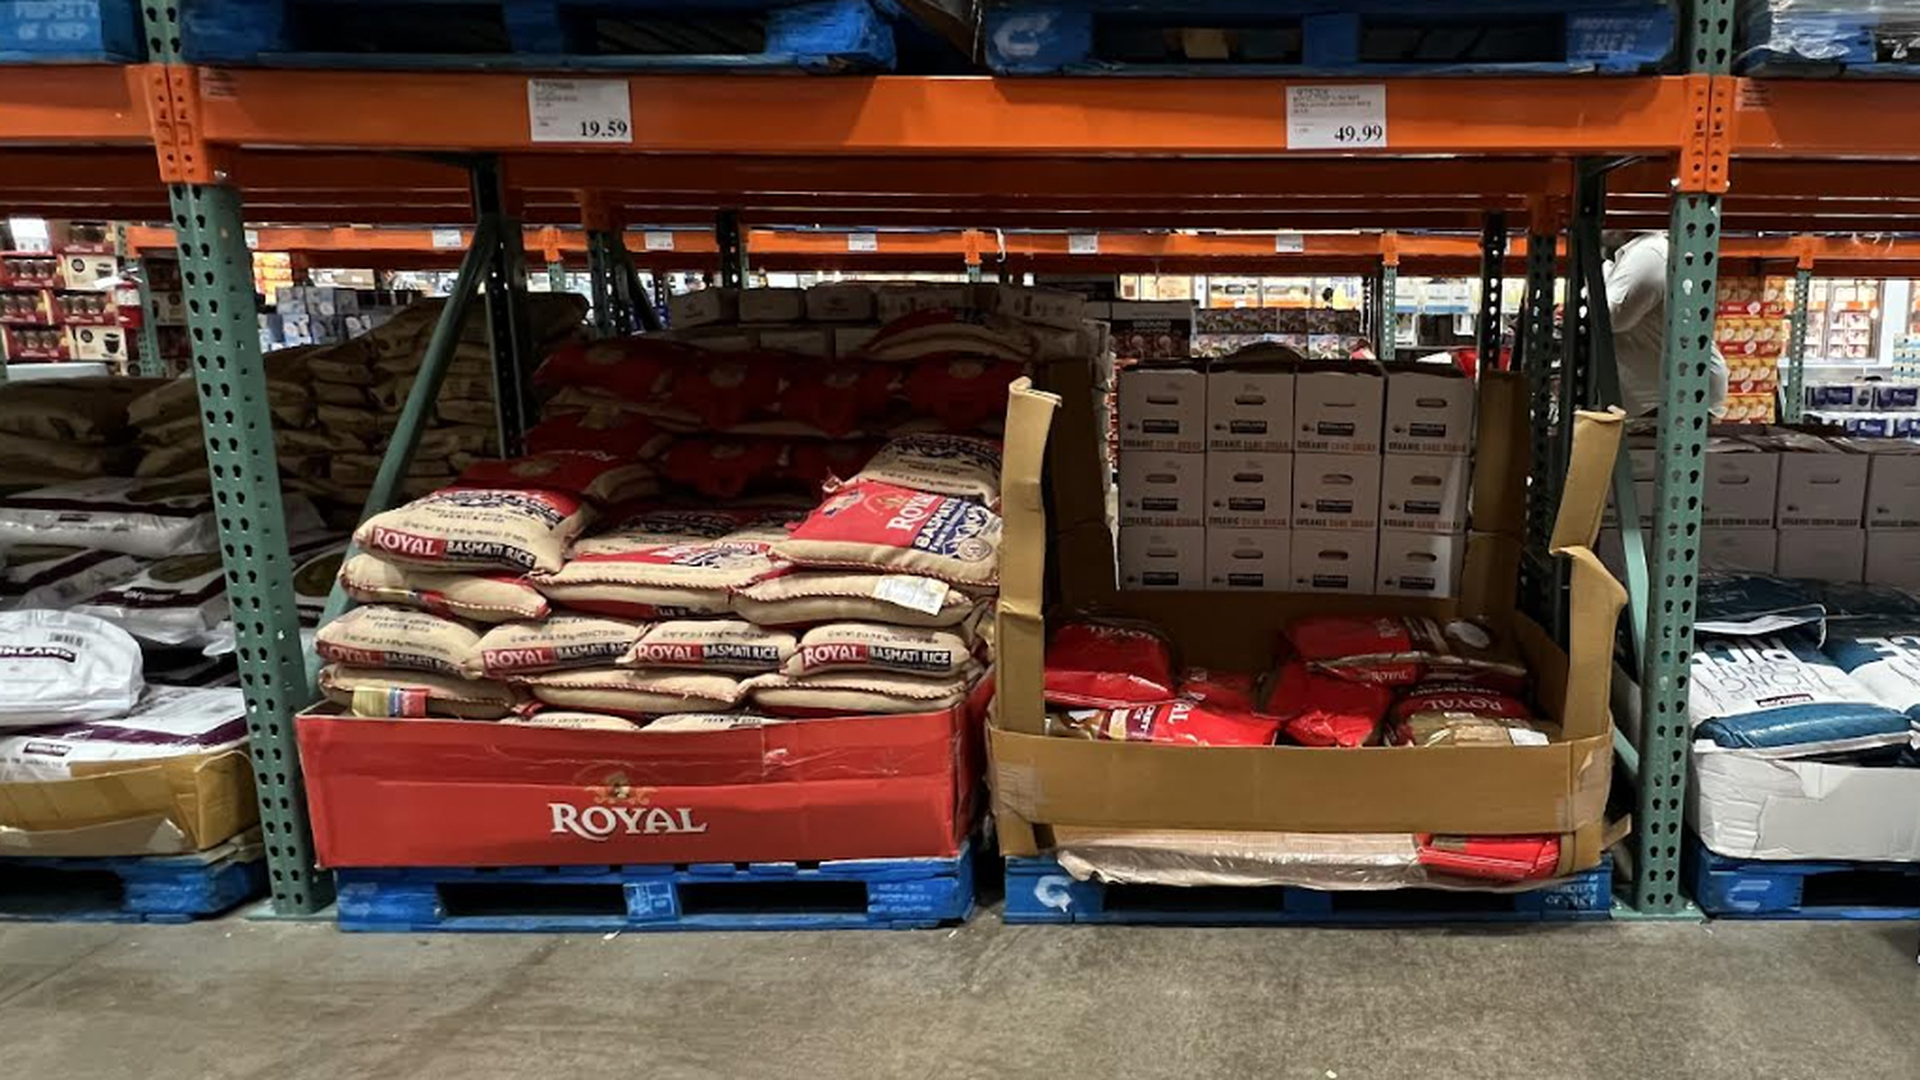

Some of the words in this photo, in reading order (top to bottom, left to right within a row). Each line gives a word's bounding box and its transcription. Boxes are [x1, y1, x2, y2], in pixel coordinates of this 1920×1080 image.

[581, 121, 628, 137] 19.59
[1334, 125, 1383, 142] 49.99
[374, 528, 438, 556] ROYAL
[447, 541, 504, 557] BASMATI
[505, 547, 534, 568] RICE
[485, 650, 550, 668] ROYAL
[637, 645, 693, 663] ROYAL
[702, 646, 751, 658] BASMATI
[752, 646, 778, 659] RICE
[803, 645, 863, 667] ROYAL
[869, 646, 920, 662] BASMATI
[922, 651, 950, 664] RICE
[1371, 670, 1409, 683] ROYAL
[547, 803, 708, 841] ROYAL
